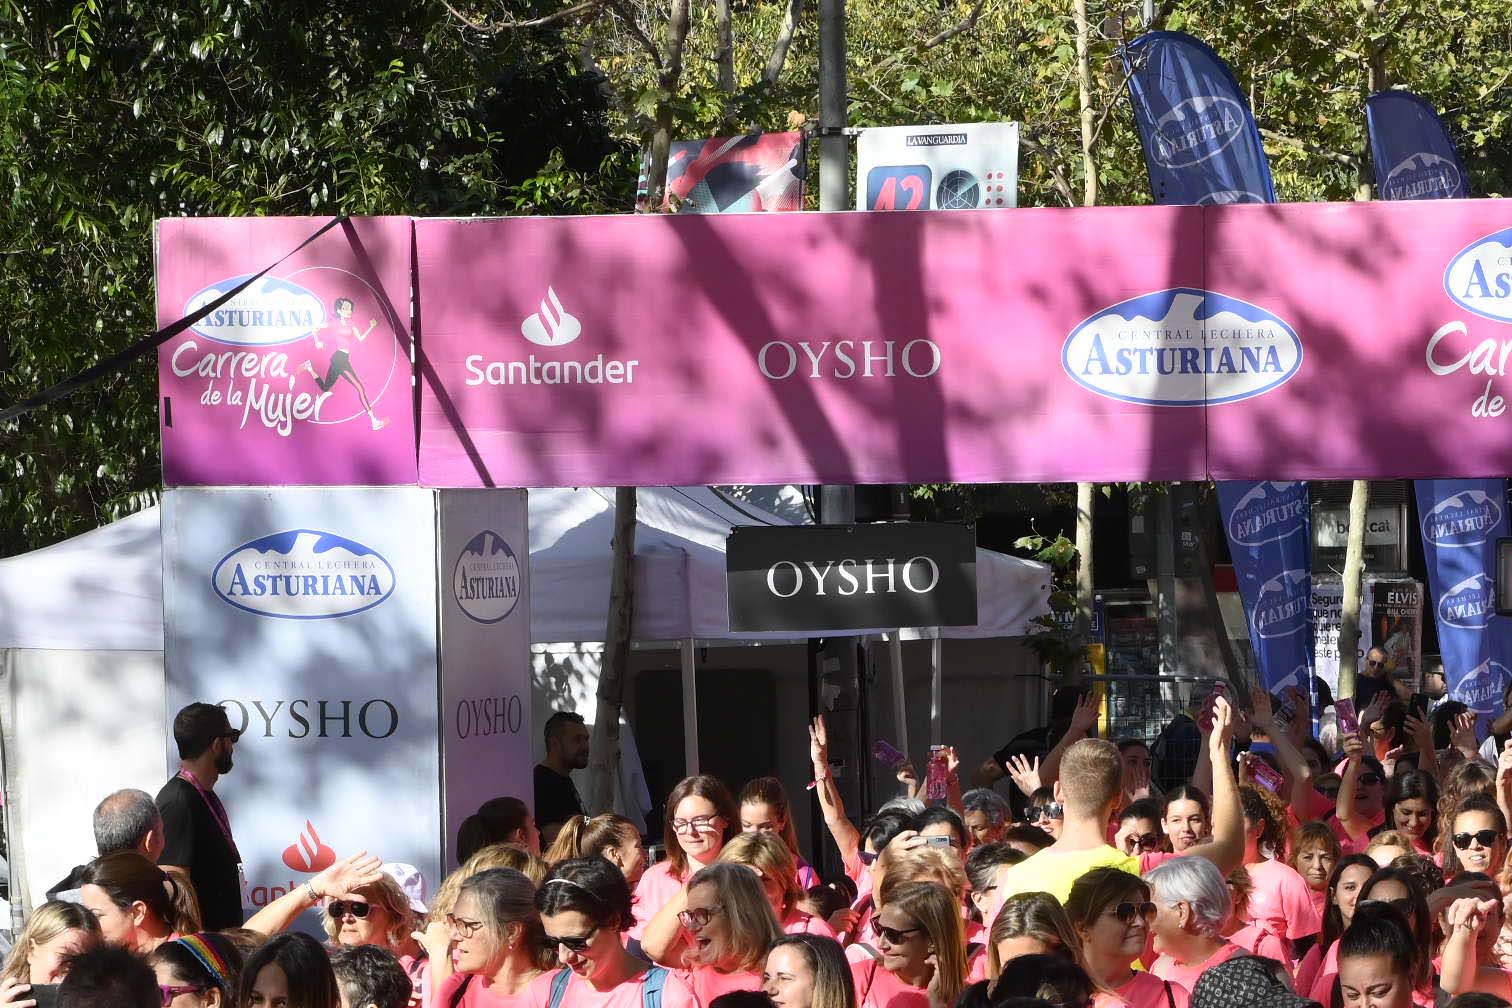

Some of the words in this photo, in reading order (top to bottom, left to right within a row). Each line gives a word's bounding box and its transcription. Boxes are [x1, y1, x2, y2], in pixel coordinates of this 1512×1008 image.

[917, 134, 967, 146] VANGUARDIA
[1117, 328, 1193, 341] CENTRAL
[1201, 326, 1277, 341] LECHERA
[171, 340, 288, 379] Carrera
[465, 353, 639, 386] Santander
[757, 338, 942, 381] OYSHO
[1080, 332, 1285, 377] ASTURIANA
[200, 380, 222, 406] de
[227, 380, 243, 406] la
[240, 374, 333, 437] Mujer
[1471, 379, 1506, 418] de
[227, 562, 383, 597] ASTURIANA
[255, 560, 314, 570] CENTRAL
[317, 560, 376, 569] LECHERA
[459, 564, 517, 601] ASTURIANA
[767, 556, 939, 598] OYSHO
[456, 695, 523, 741] OYSHO
